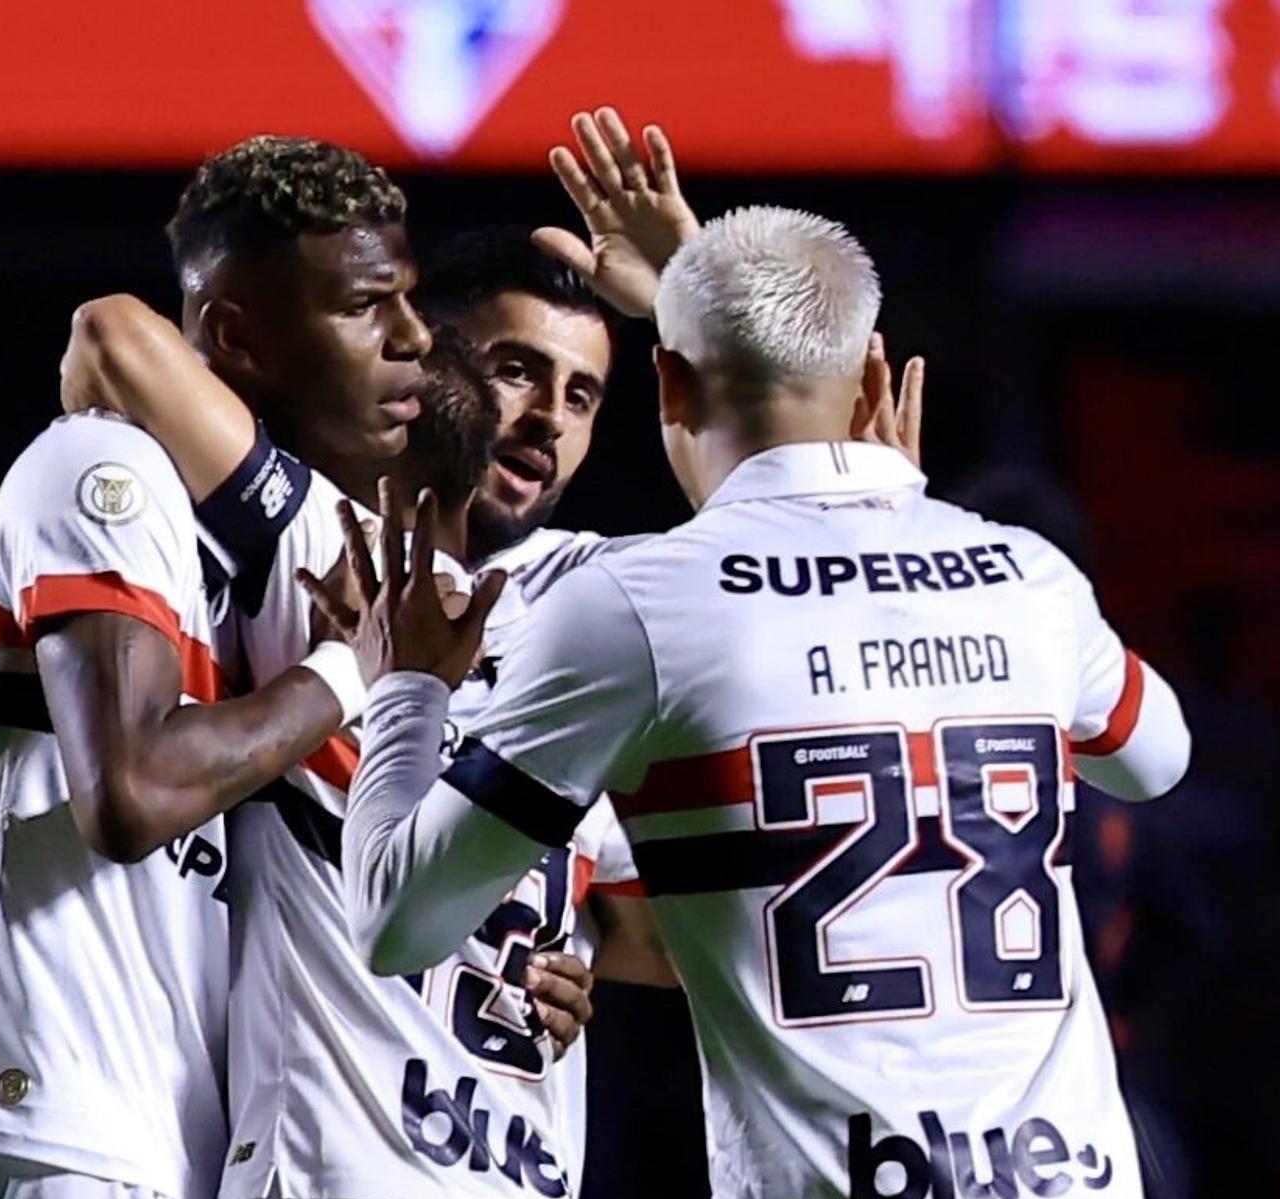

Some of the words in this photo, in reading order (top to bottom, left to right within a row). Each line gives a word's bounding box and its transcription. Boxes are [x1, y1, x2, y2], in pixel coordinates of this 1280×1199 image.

[719, 543, 1024, 597] SUPERBET
[807, 645, 847, 695] A.
[859, 634, 1010, 691] FRANCO
[748, 713, 1075, 1029] 28
